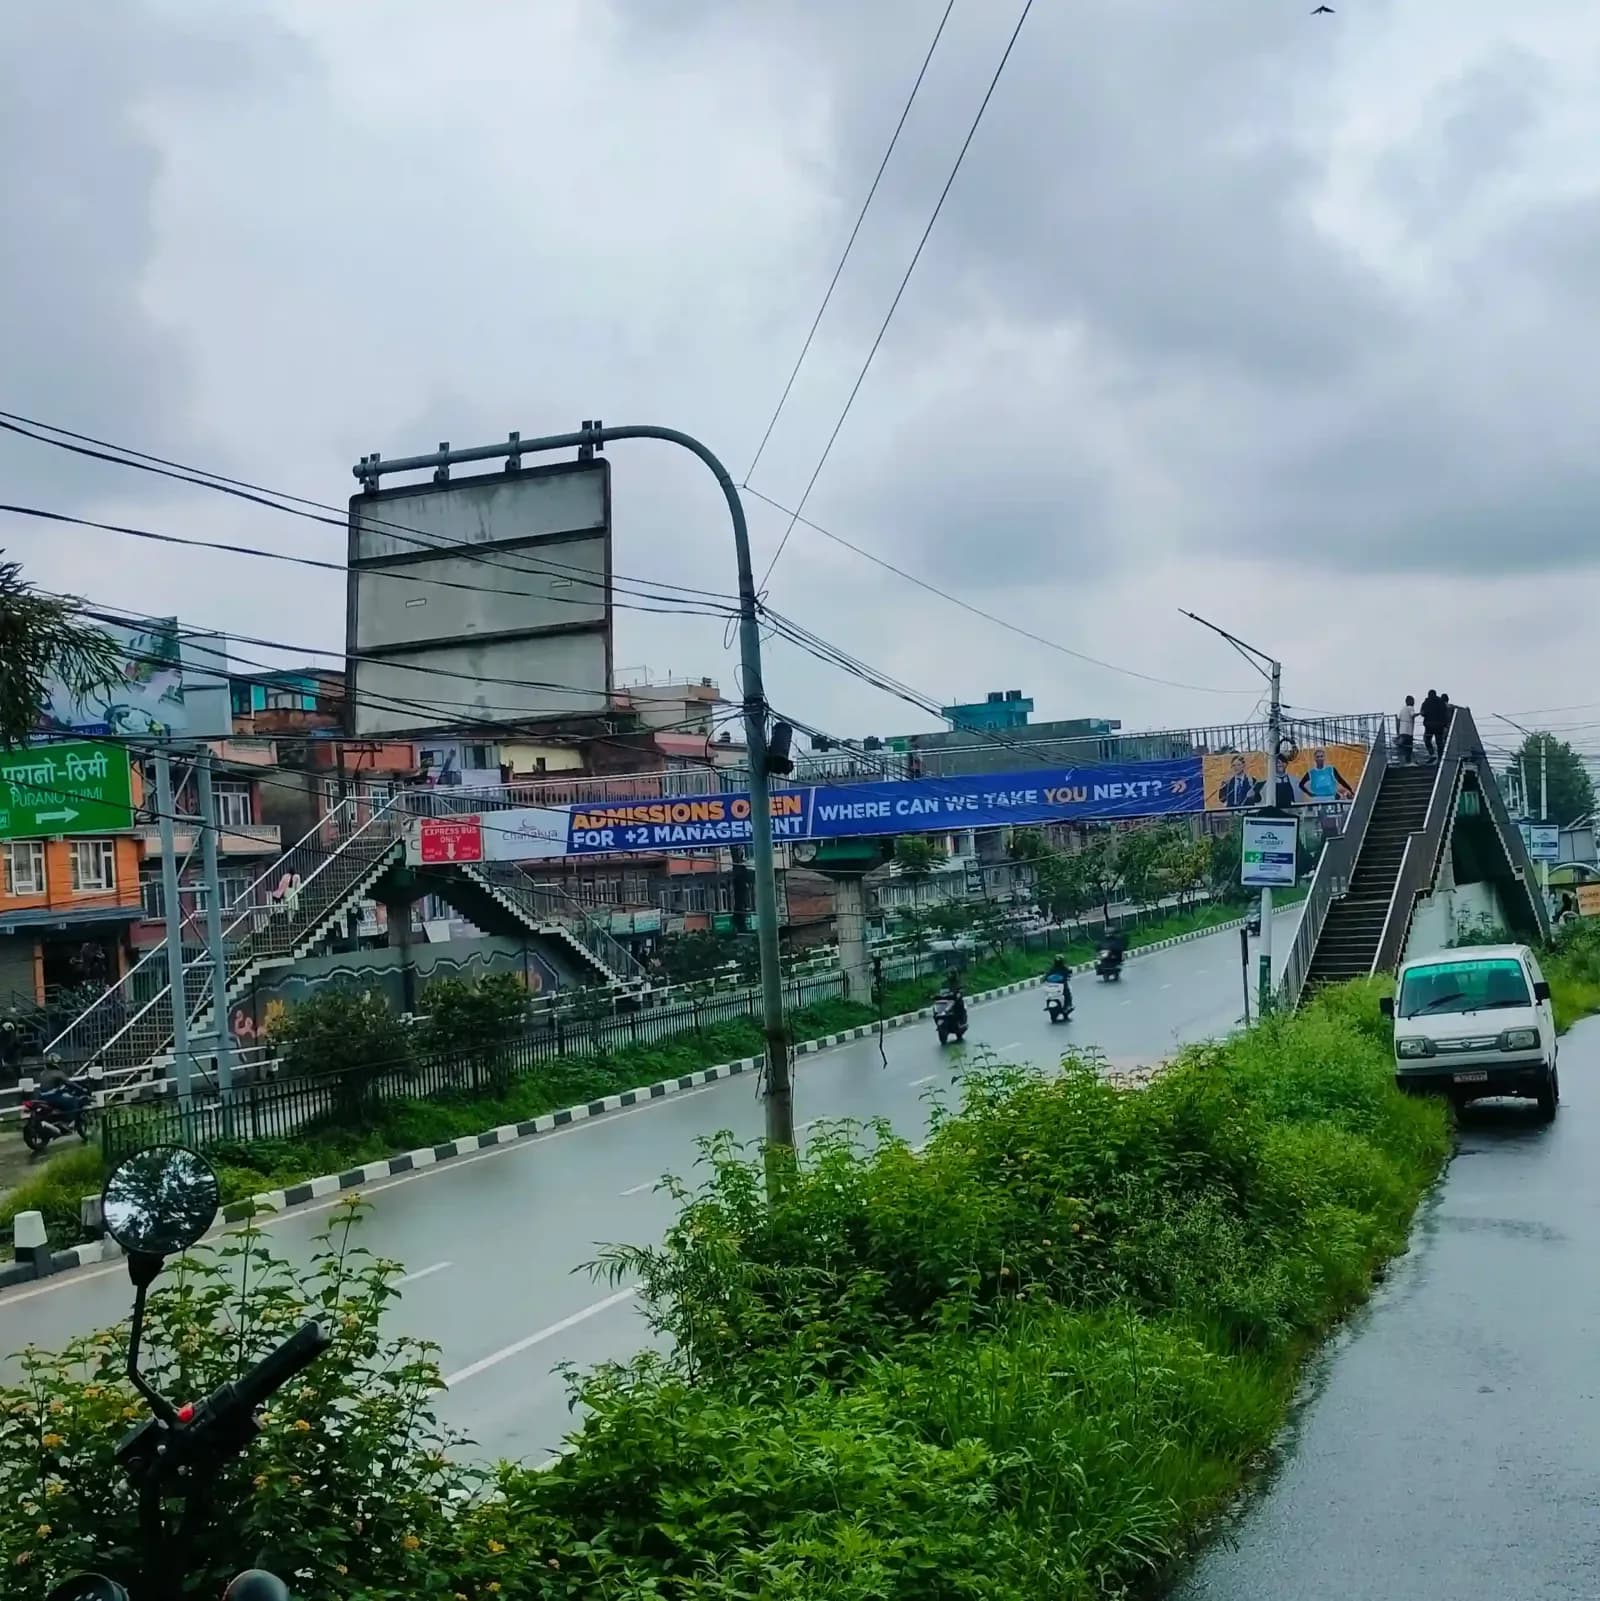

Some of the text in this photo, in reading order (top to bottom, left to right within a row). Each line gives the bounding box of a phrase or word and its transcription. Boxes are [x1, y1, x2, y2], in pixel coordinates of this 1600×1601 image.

[572, 795, 801, 830] ADMISSIONS OEN
[818, 780, 1162, 821] WHERE CAN WE TAKE YOU NEXT?
[573, 830, 615, 848] FOR
[625, 827, 649, 844] +2
